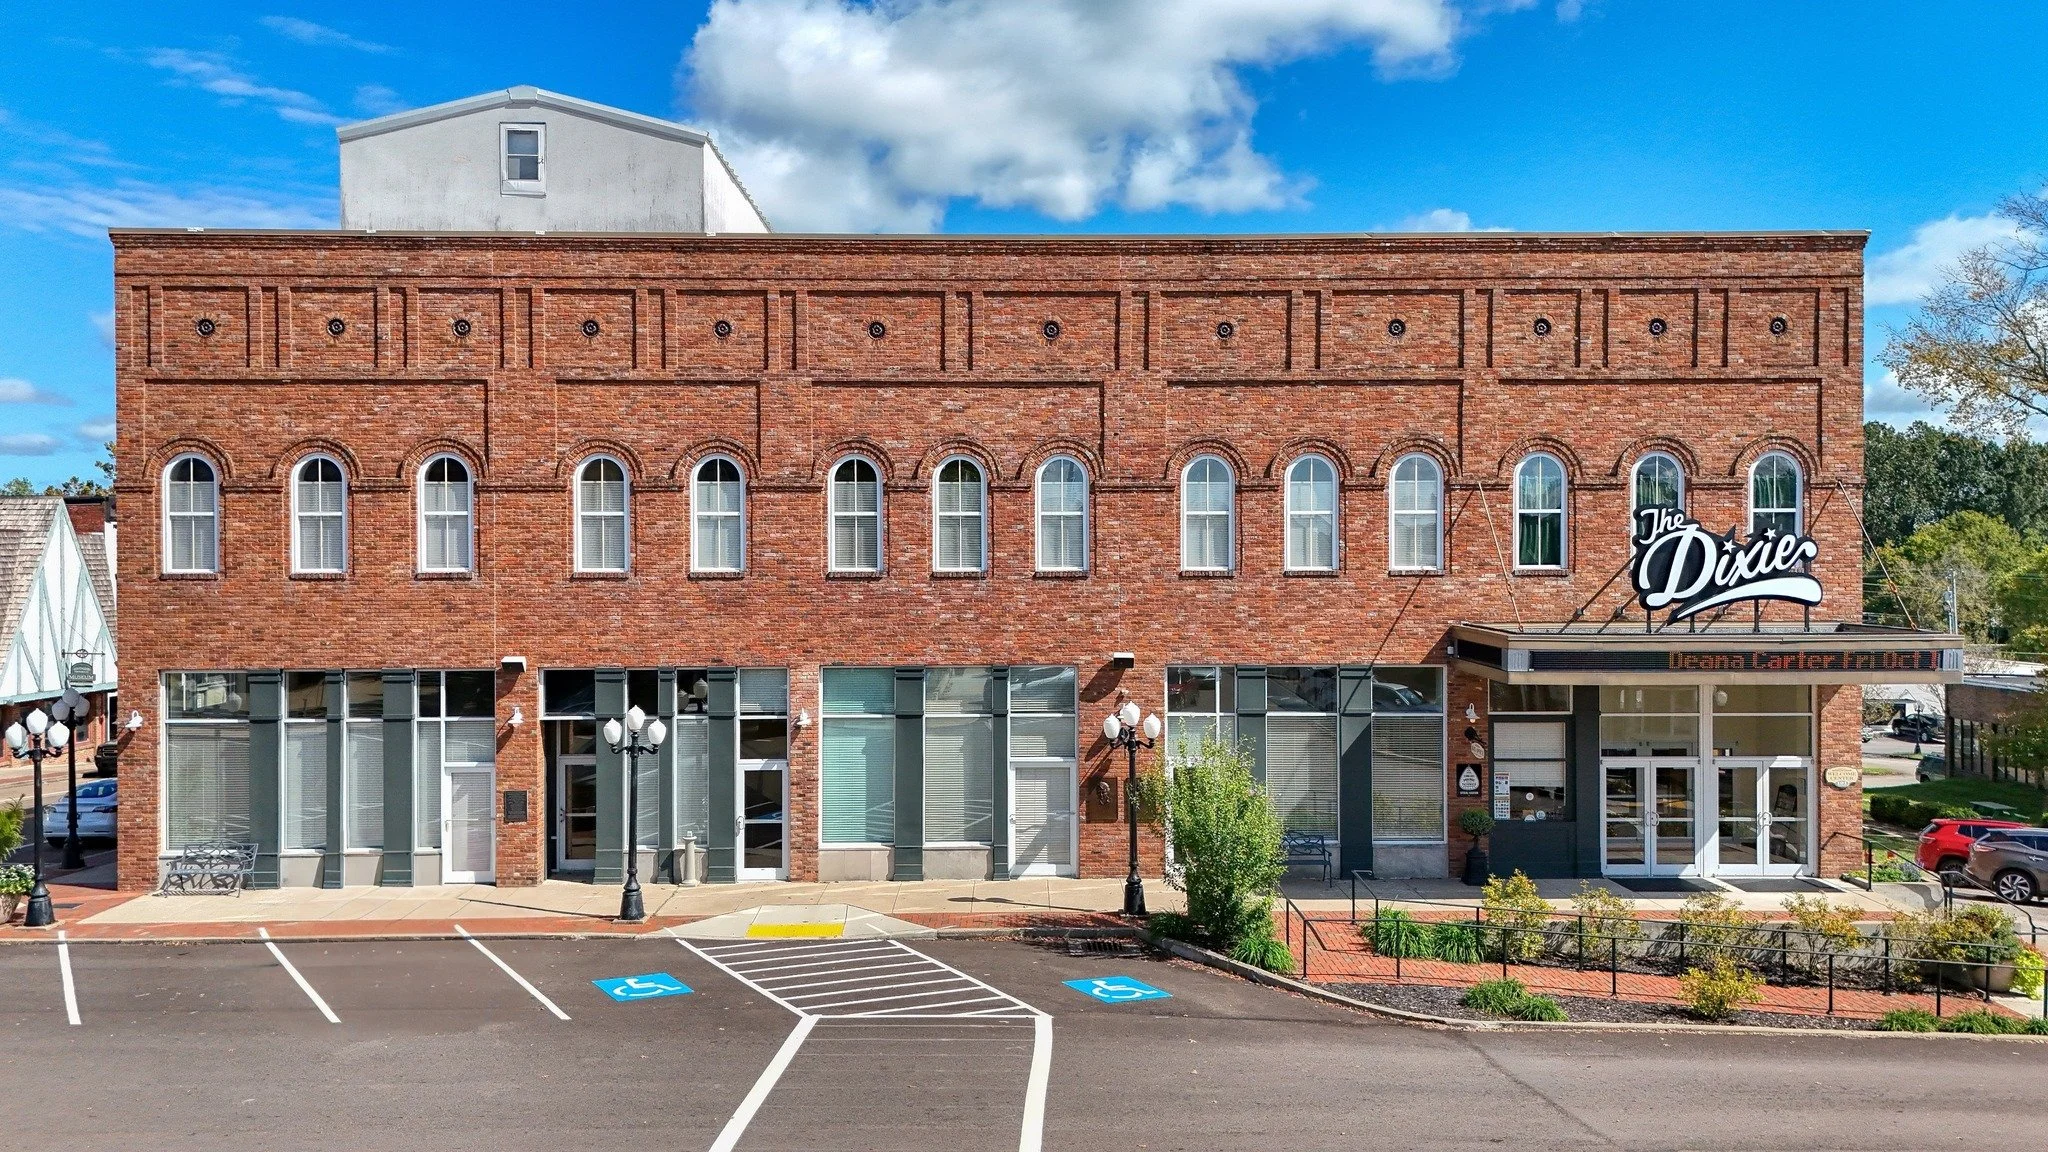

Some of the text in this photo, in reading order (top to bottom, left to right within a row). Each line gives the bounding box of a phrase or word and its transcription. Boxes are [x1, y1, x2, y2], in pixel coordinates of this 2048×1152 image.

[1639, 507, 1690, 545] The
[1638, 523, 1818, 607] Dixie
[1668, 650, 1745, 670] Deana
[1752, 650, 1835, 670] Carter
[1842, 650, 1876, 670] Fri
[1883, 650, 1922, 670] Oct
